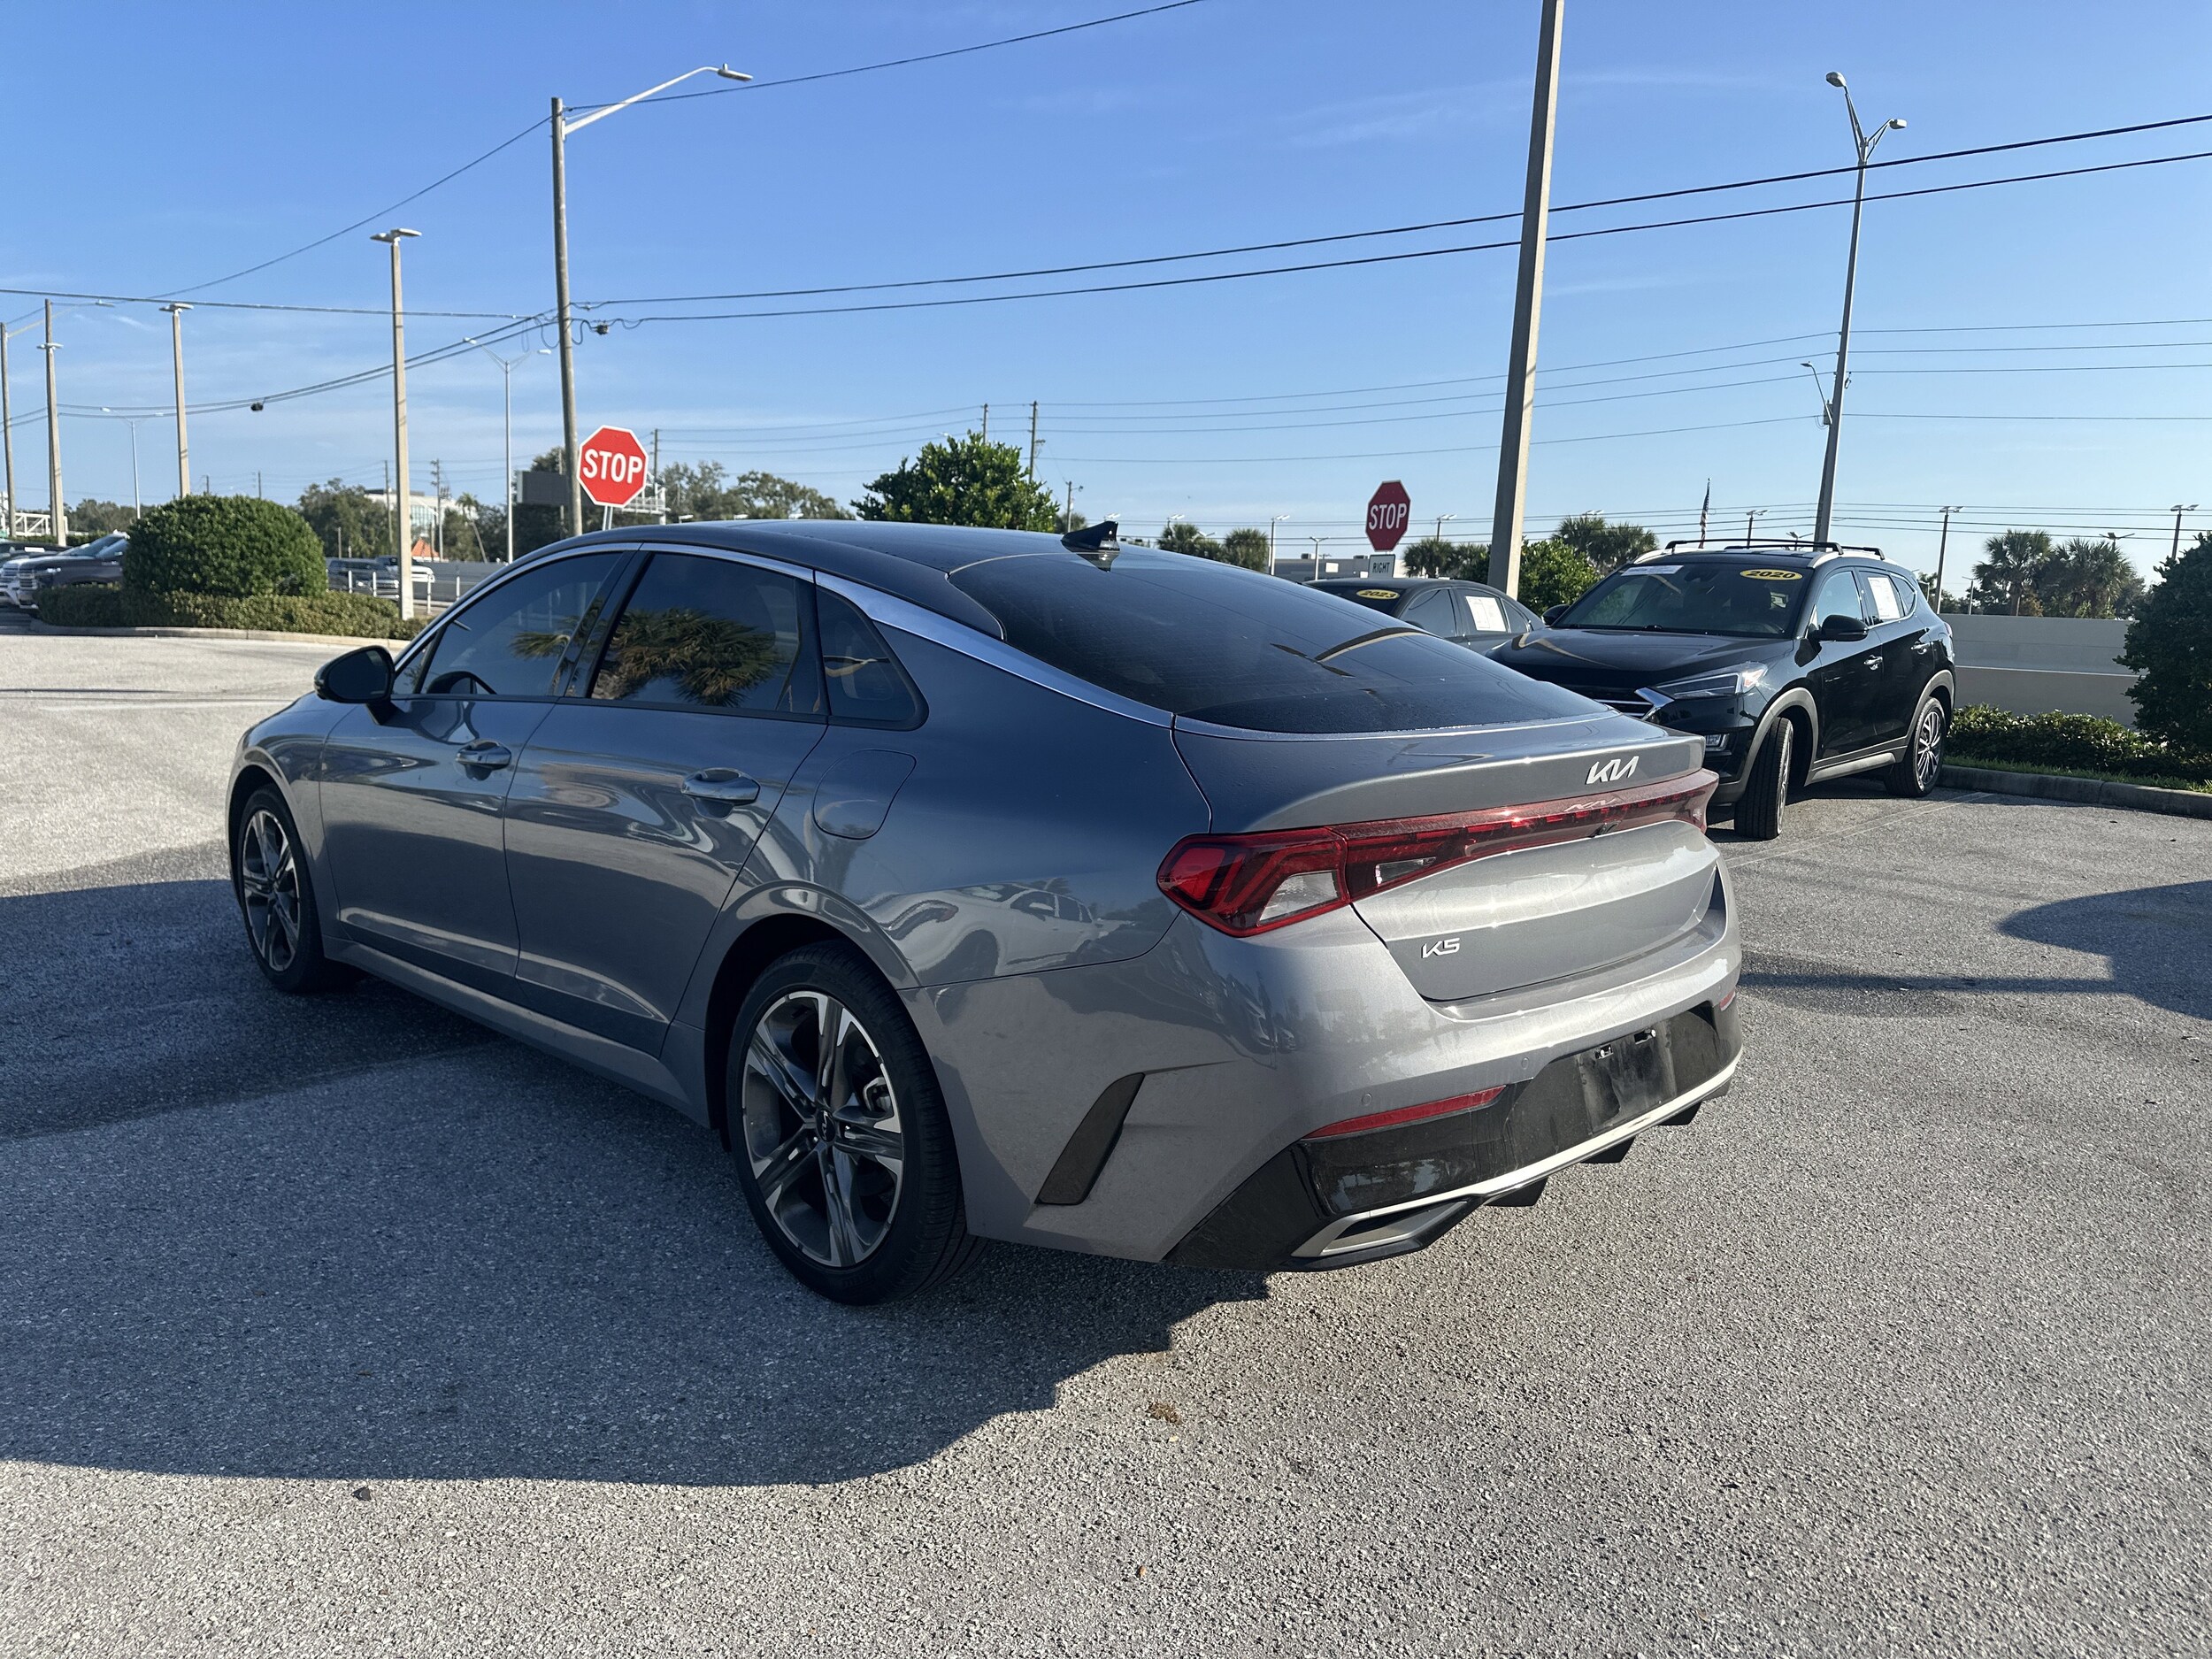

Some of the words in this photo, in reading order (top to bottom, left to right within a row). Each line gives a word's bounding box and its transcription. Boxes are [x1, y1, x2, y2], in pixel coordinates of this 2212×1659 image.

[582, 448, 644, 484] STOP
[1368, 503, 1408, 530] STOP
[1372, 562, 1391, 573] RIGHT
[1747, 570, 1796, 579] 2020
[1586, 756, 1640, 785] KIA
[1421, 937, 1461, 959] K5
